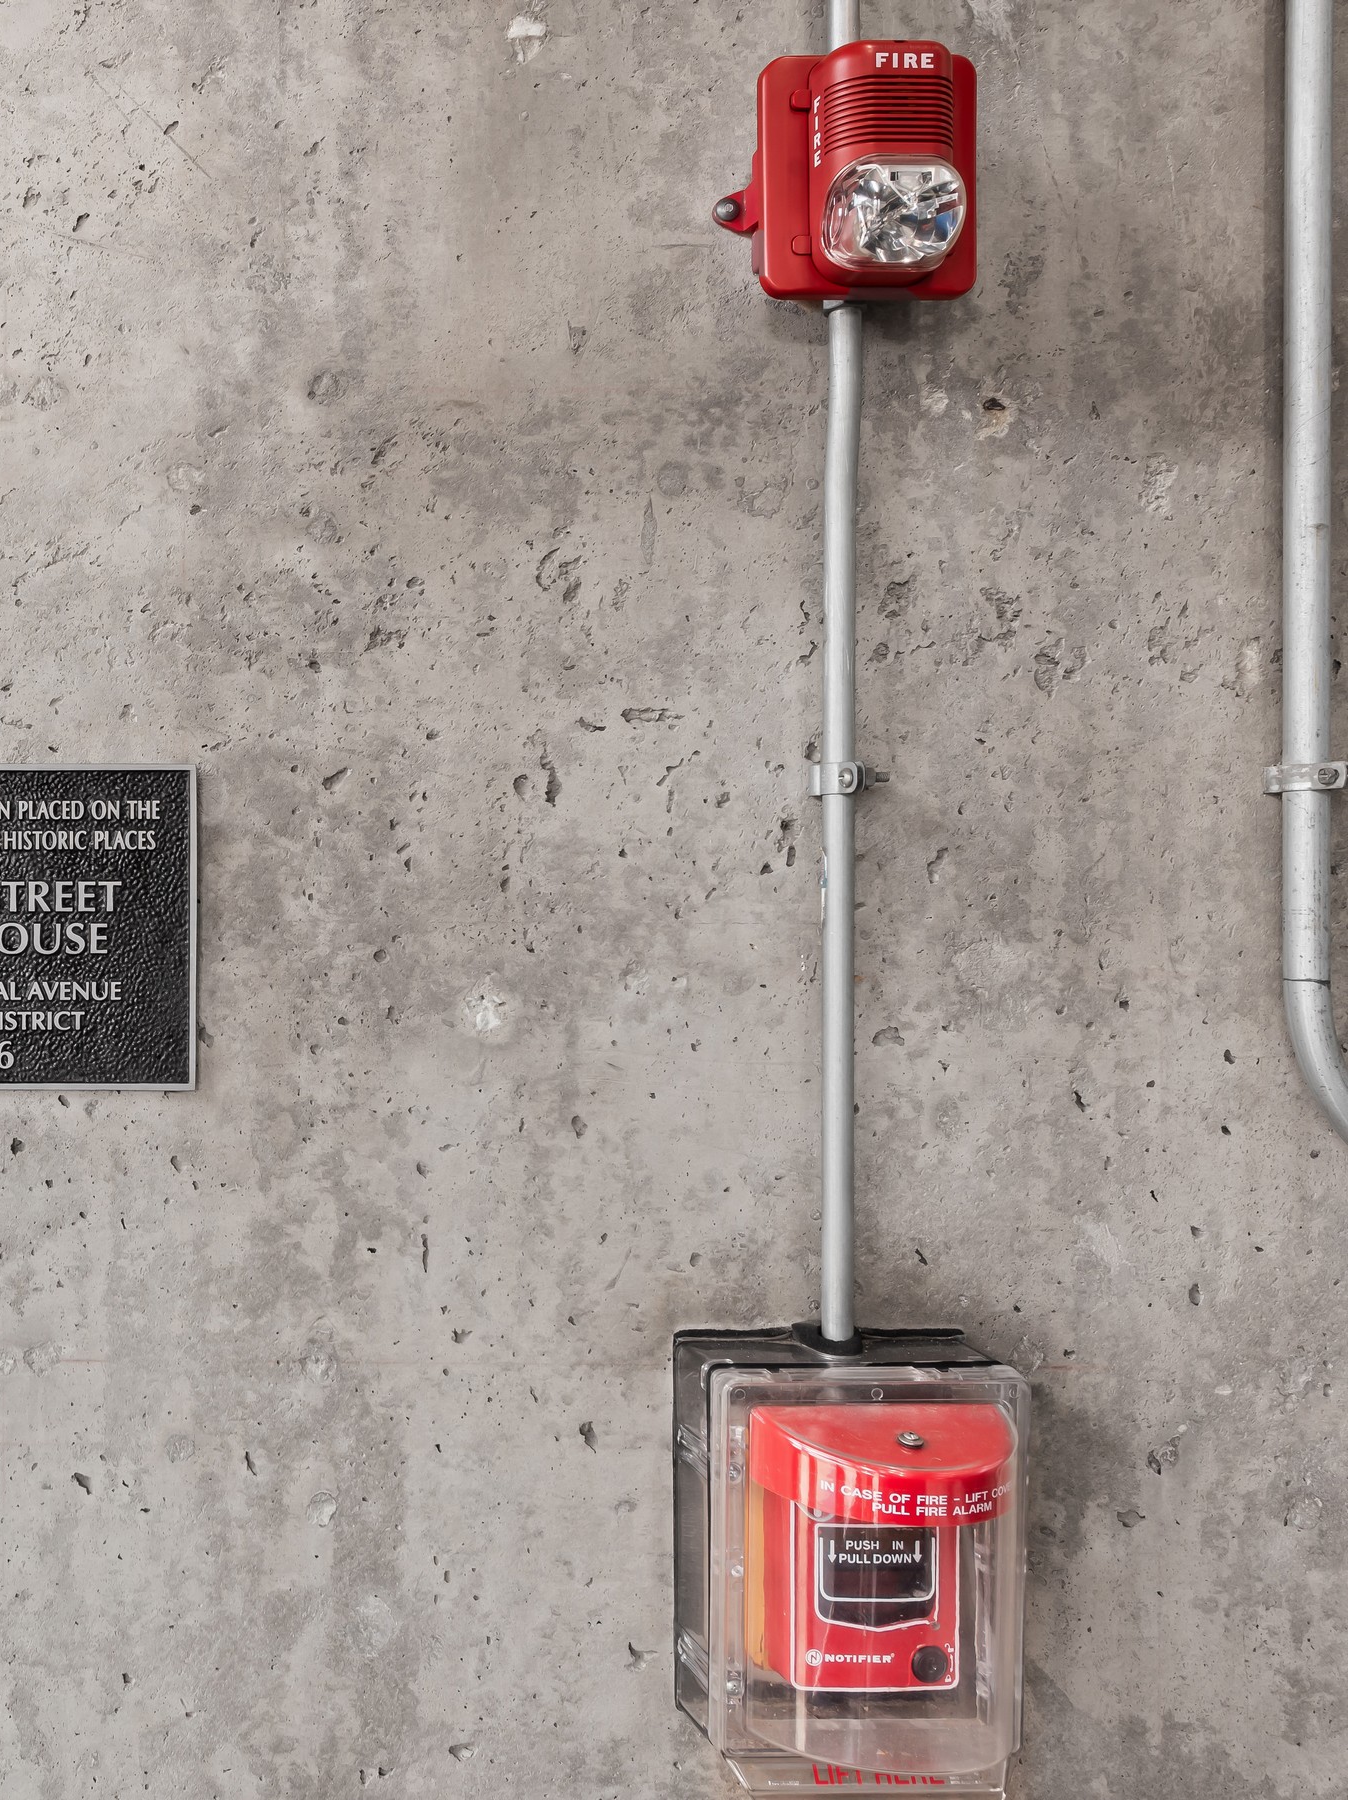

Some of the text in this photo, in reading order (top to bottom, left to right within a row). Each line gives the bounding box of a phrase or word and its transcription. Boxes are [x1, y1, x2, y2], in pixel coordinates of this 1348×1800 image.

[875, 52, 934, 69] FIRE
[813, 96, 821, 168] FIRE
[17, 799, 84, 821] PLACED
[91, 799, 120, 821] ON
[126, 799, 161, 821] THE
[3, 830, 87, 850] HISTORIC
[93, 830, 157, 850] PLACES
[26, 980, 122, 1001] AVENUE
[820, 1480, 834, 1492] IN
[840, 1485, 883, 1501] CASE
[889, 1493, 911, 1504] OF
[916, 1495, 948, 1506] FIRE
[965, 1490, 989, 1504] LIFT
[871, 1501, 992, 1516] PULL FIRE ALARM
[845, 1540, 904, 1551] PUSH IN
[838, 1553, 912, 1564] PULL DOWN
